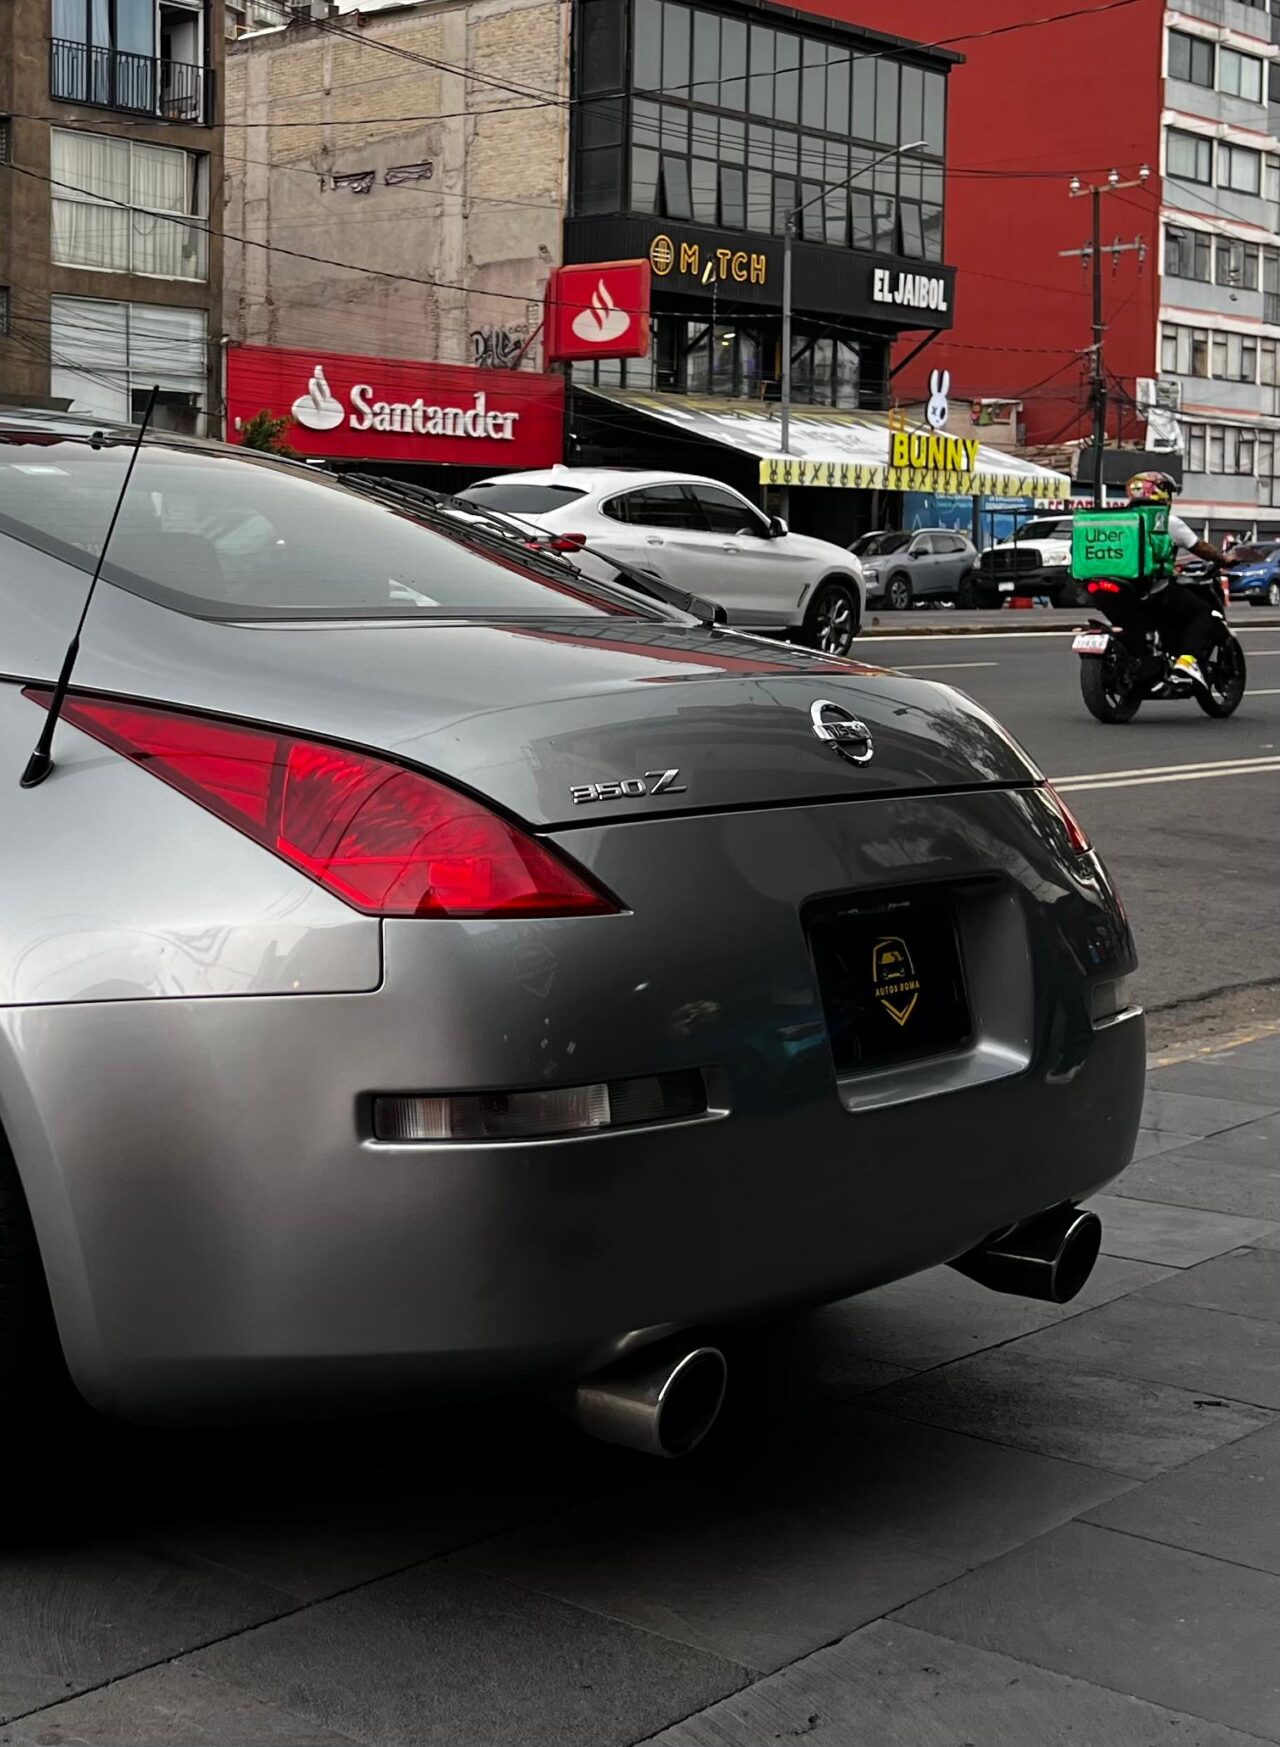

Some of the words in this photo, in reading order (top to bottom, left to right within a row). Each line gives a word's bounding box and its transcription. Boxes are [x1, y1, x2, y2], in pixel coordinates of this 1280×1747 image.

[873, 268, 893, 303] EL
[894, 272, 948, 312] JAIBOL
[349, 384, 519, 440] Santander
[890, 431, 980, 473] BUNNY
[1085, 527, 1125, 543] Uber
[1085, 545, 1124, 560] Eats
[569, 768, 688, 804] 350Z
[875, 984, 898, 997] AUTOS
